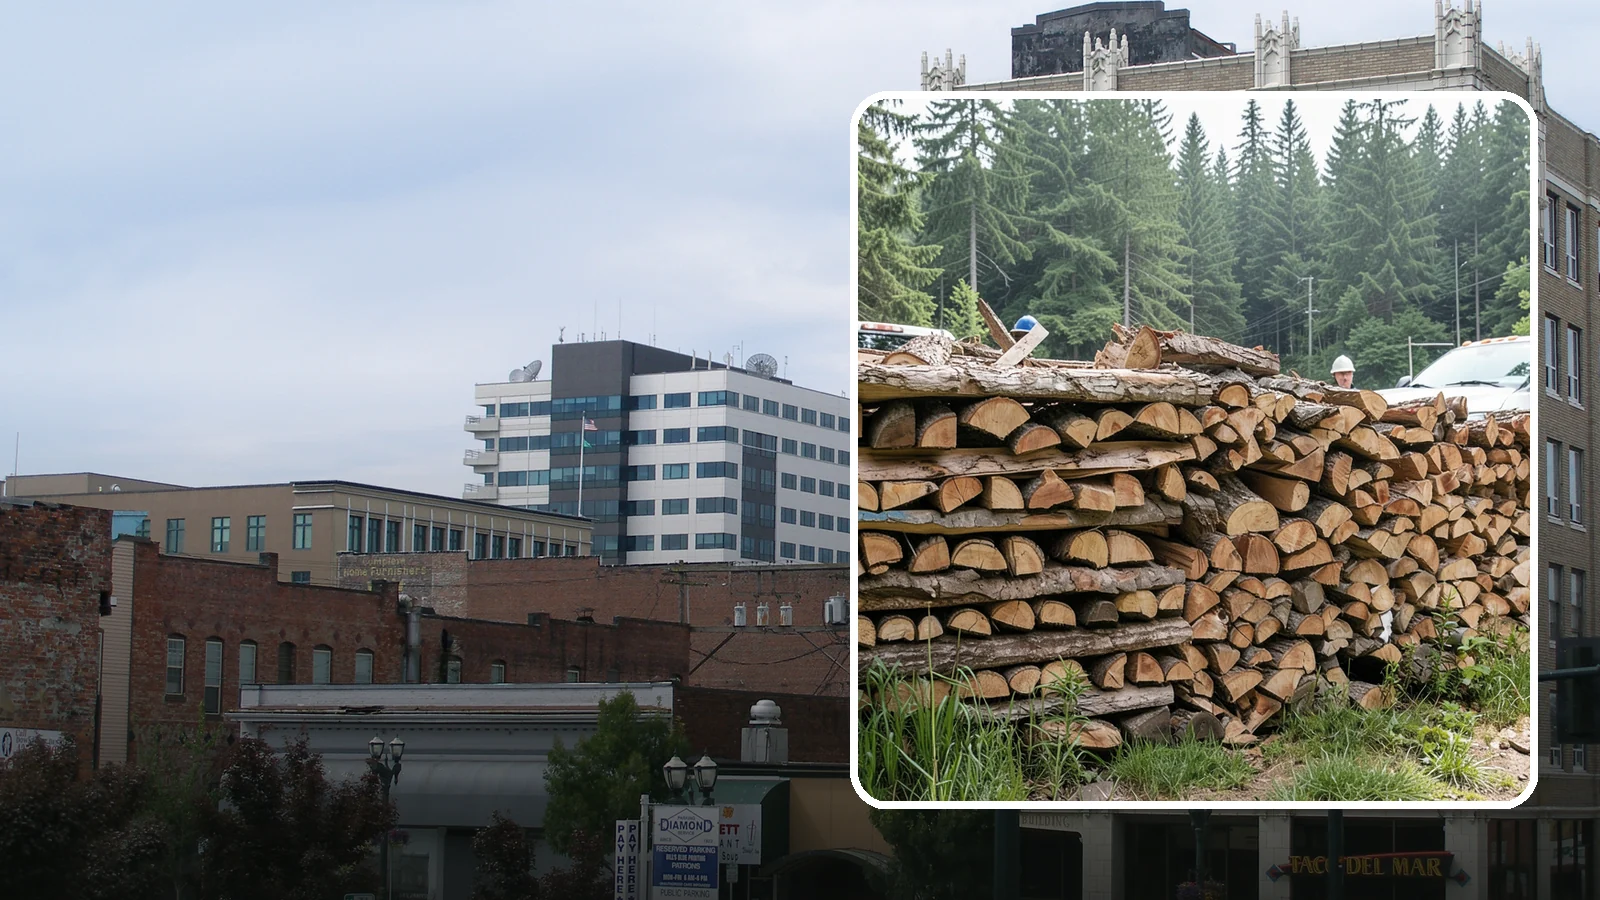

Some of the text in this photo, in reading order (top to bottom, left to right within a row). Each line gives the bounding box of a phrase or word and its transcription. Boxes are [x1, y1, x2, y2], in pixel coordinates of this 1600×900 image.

[343, 566, 427, 577] Home Furnishers
[660, 818, 713, 833] DIAMOND
[1022, 815, 1070, 828] BUILDING
[656, 845, 716, 854] RESERVED PARKING
[617, 824, 625, 893] PAY HERE
[627, 824, 636, 893] PAY HERE
[721, 851, 739, 862] Soup
[1345, 856, 1386, 875] DEL
[1392, 857, 1443, 876] MAR
[660, 888, 710, 898] PUBLIC PARKING
